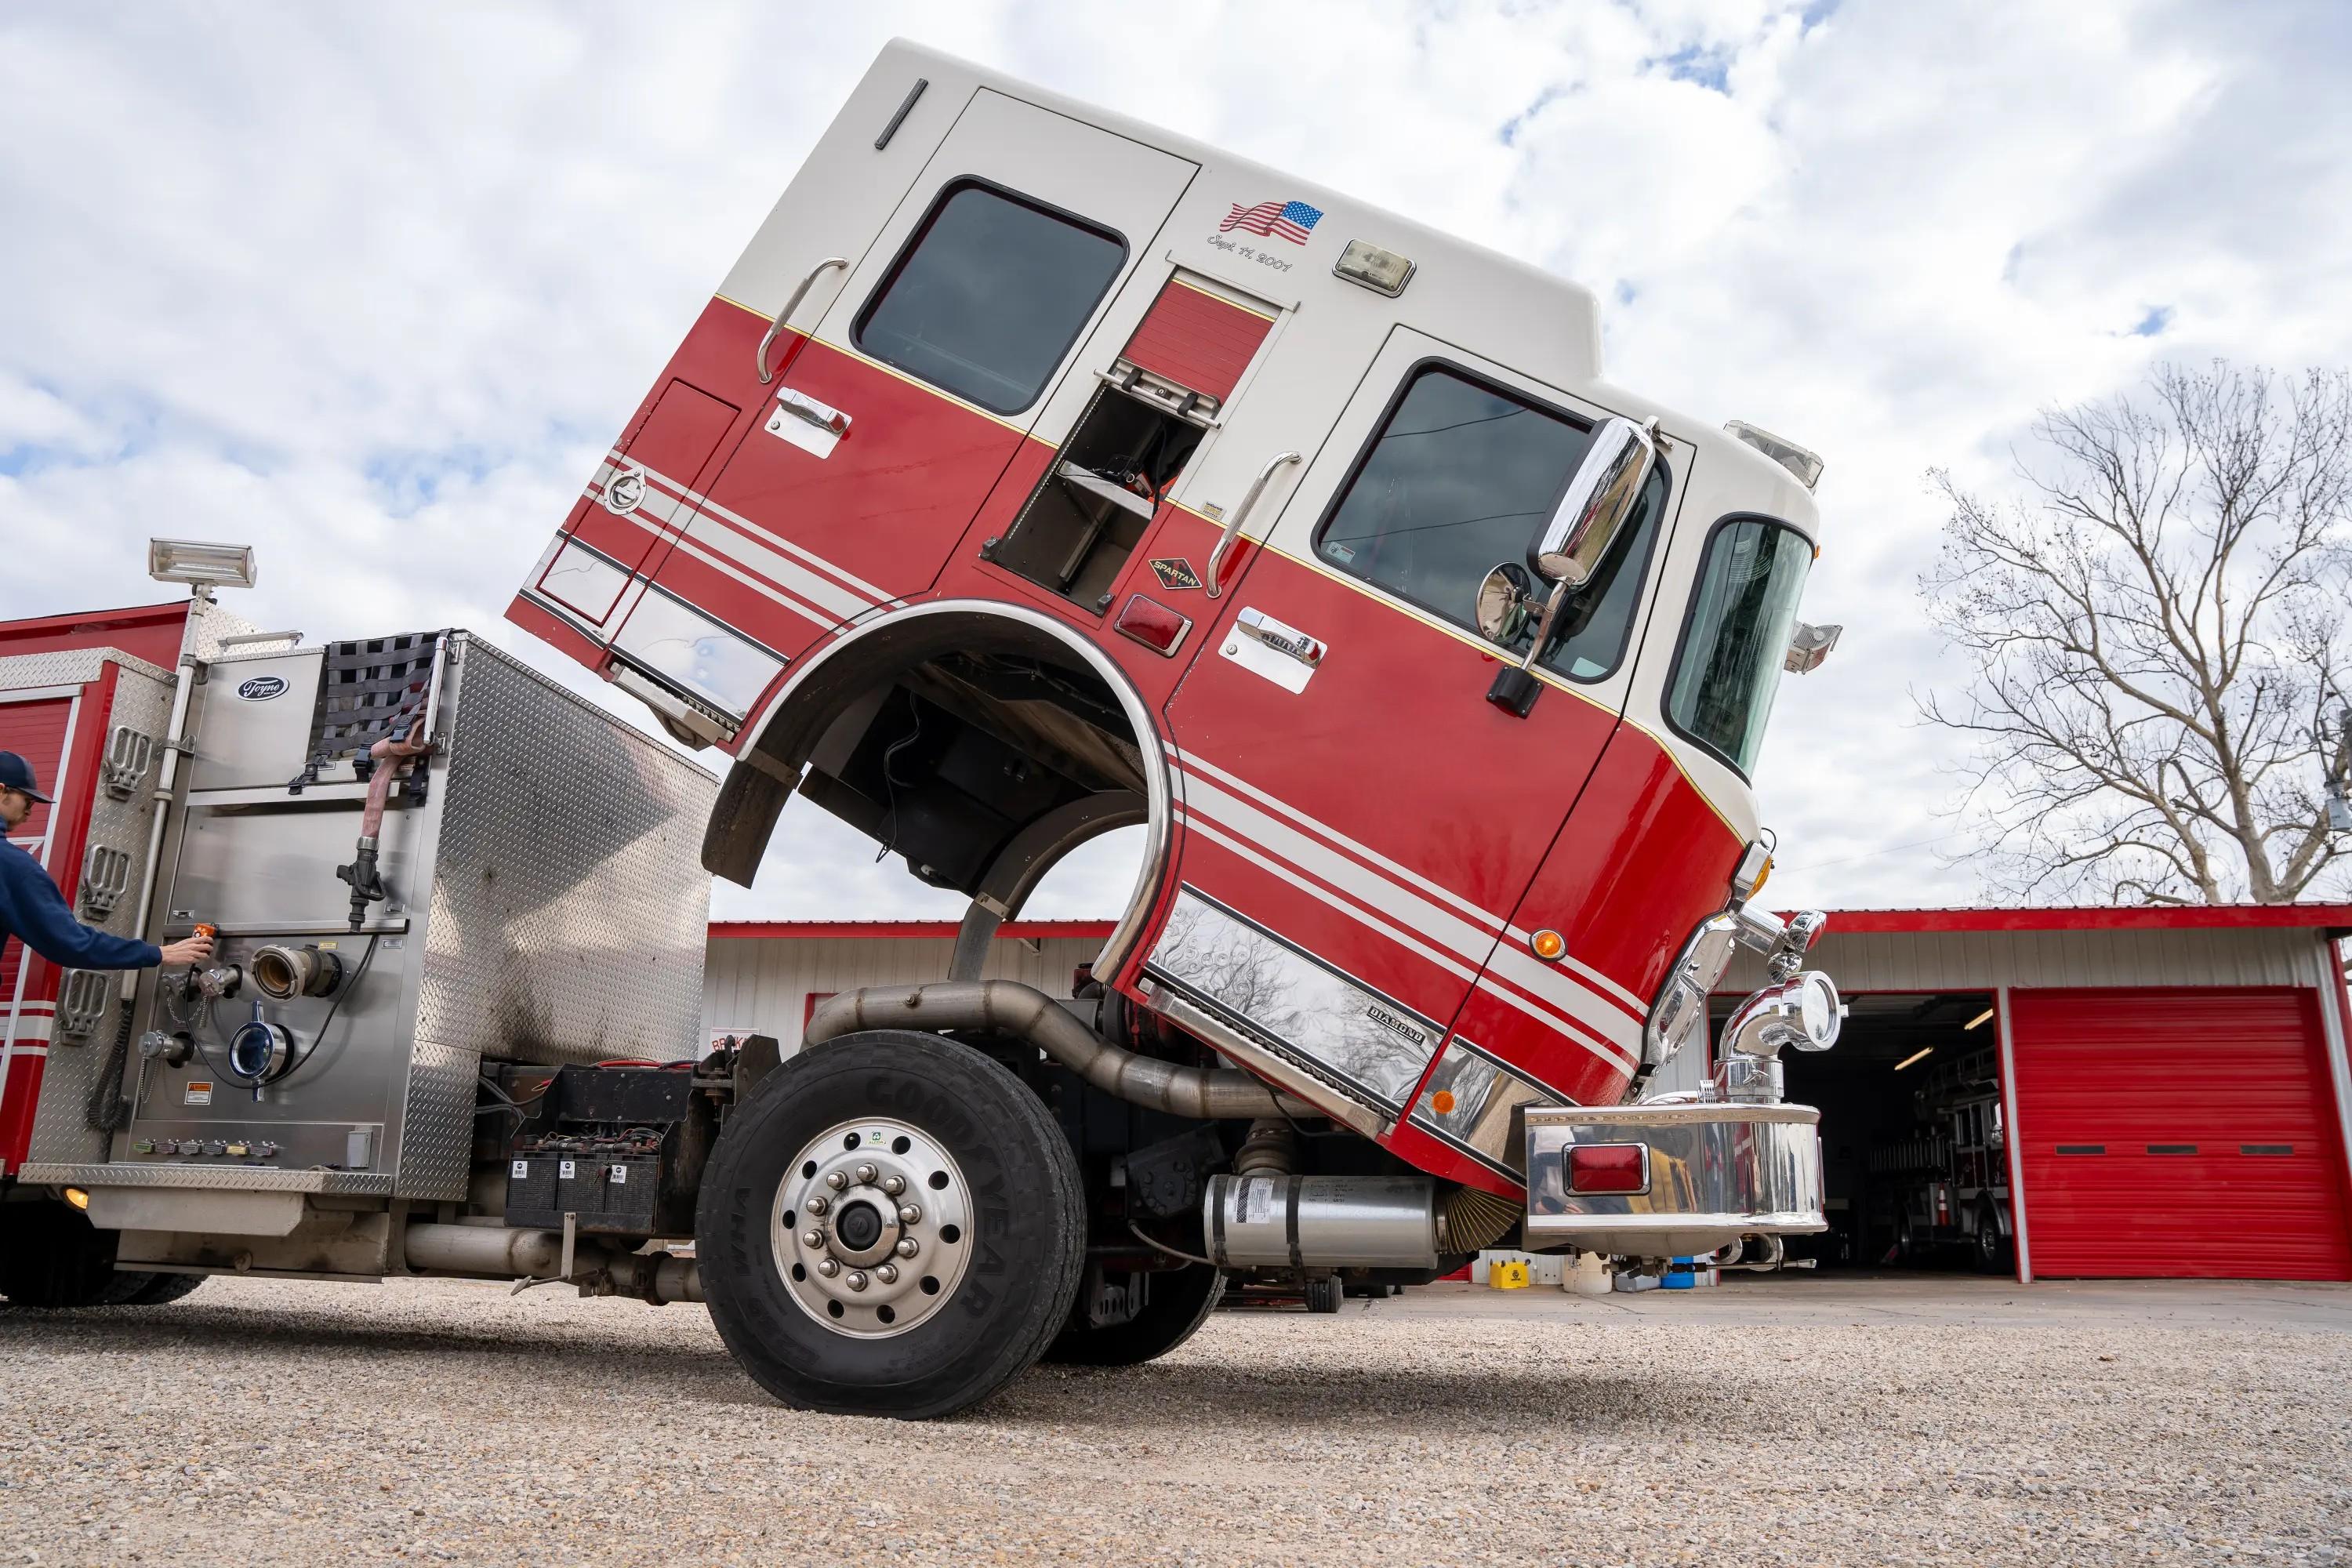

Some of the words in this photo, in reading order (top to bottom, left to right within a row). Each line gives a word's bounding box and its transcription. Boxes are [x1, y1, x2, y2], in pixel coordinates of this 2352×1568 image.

[1257, 252, 1293, 272] 2001
[1153, 561, 1197, 586] SPARTAN
[243, 680, 280, 697] Toyne
[1370, 1007, 1424, 1042] DIAMOND
